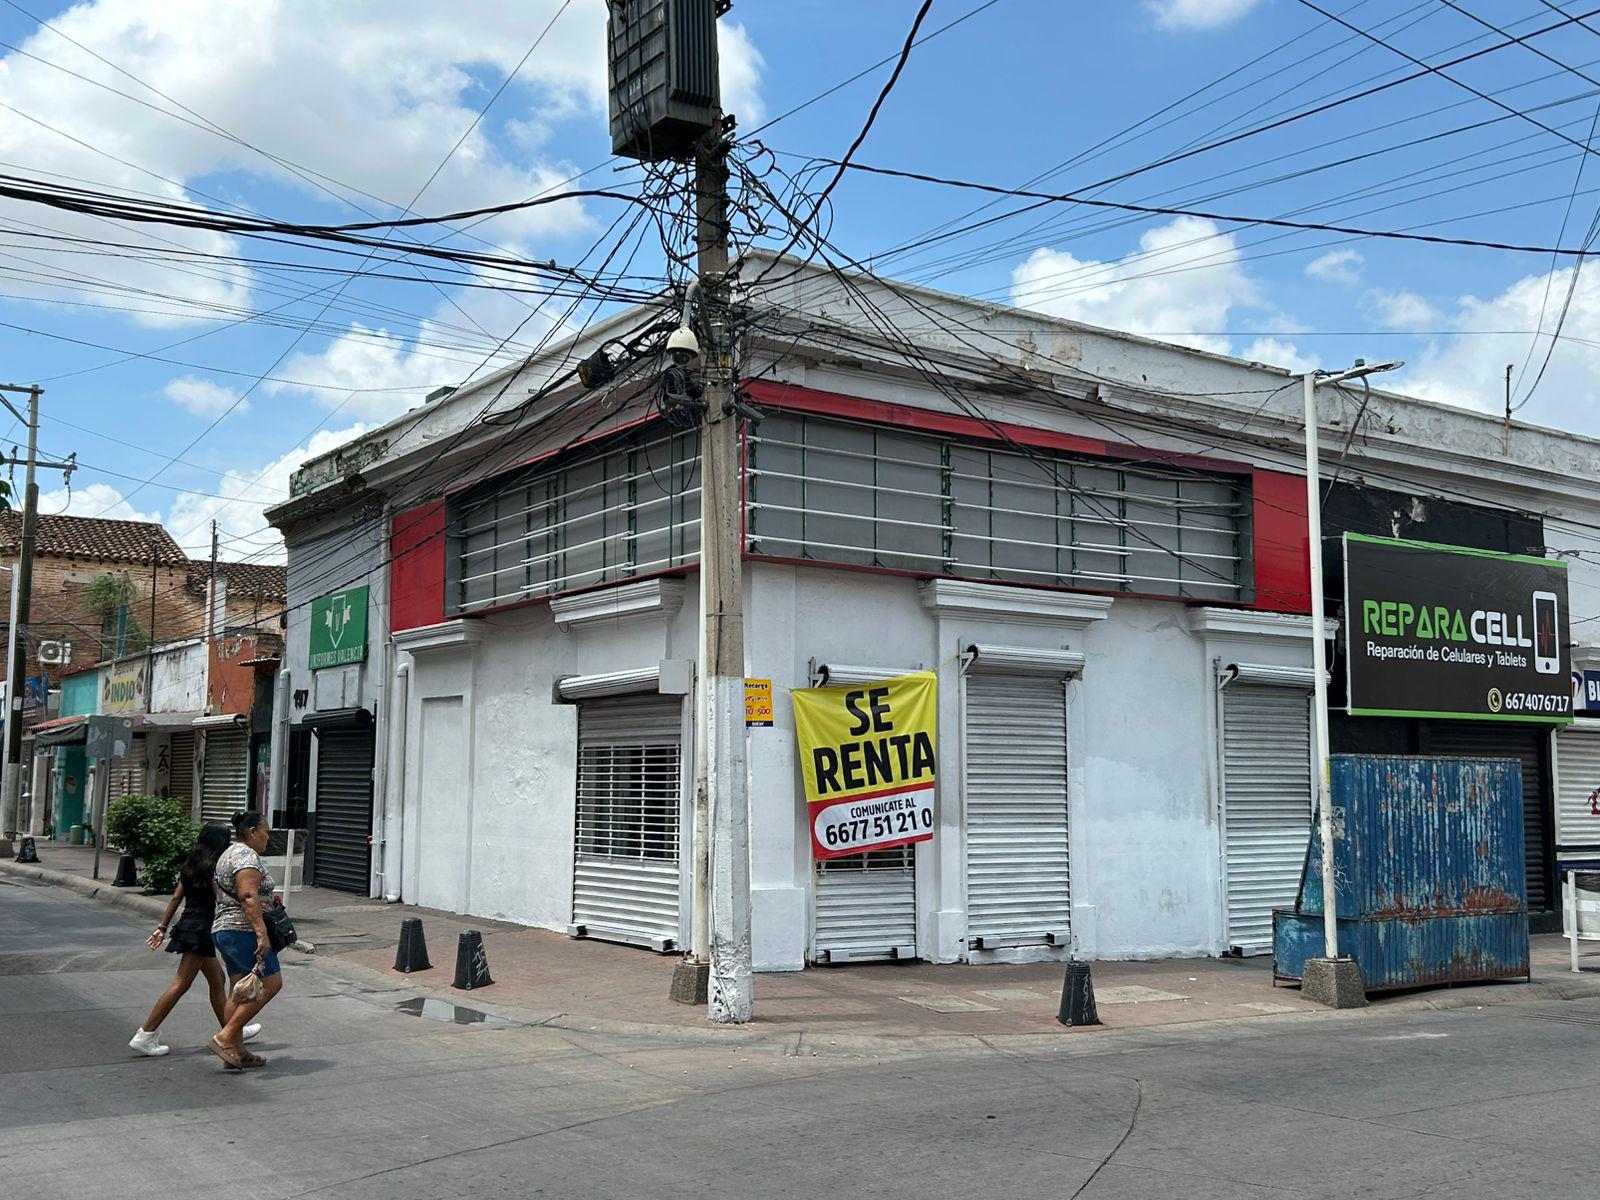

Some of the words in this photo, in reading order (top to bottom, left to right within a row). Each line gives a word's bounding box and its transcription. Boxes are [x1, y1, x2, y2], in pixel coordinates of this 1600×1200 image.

[1367, 641, 1424, 661] Reparación
[1427, 646, 1439, 660] de
[1441, 646, 1486, 664] Celulares
[1488, 654, 1495, 668] y
[1495, 650, 1527, 668] Tablets
[111, 680, 135, 703] INDIO
[1505, 693, 1570, 713] 6674076717
[844, 687, 893, 736] SE
[813, 731, 935, 794] RENTA
[850, 801, 903, 818] COMUNICATE
[905, 797, 917, 809] AL
[825, 818, 869, 845] 6677
[873, 815, 893, 838] 51
[898, 811, 918, 833] 21
